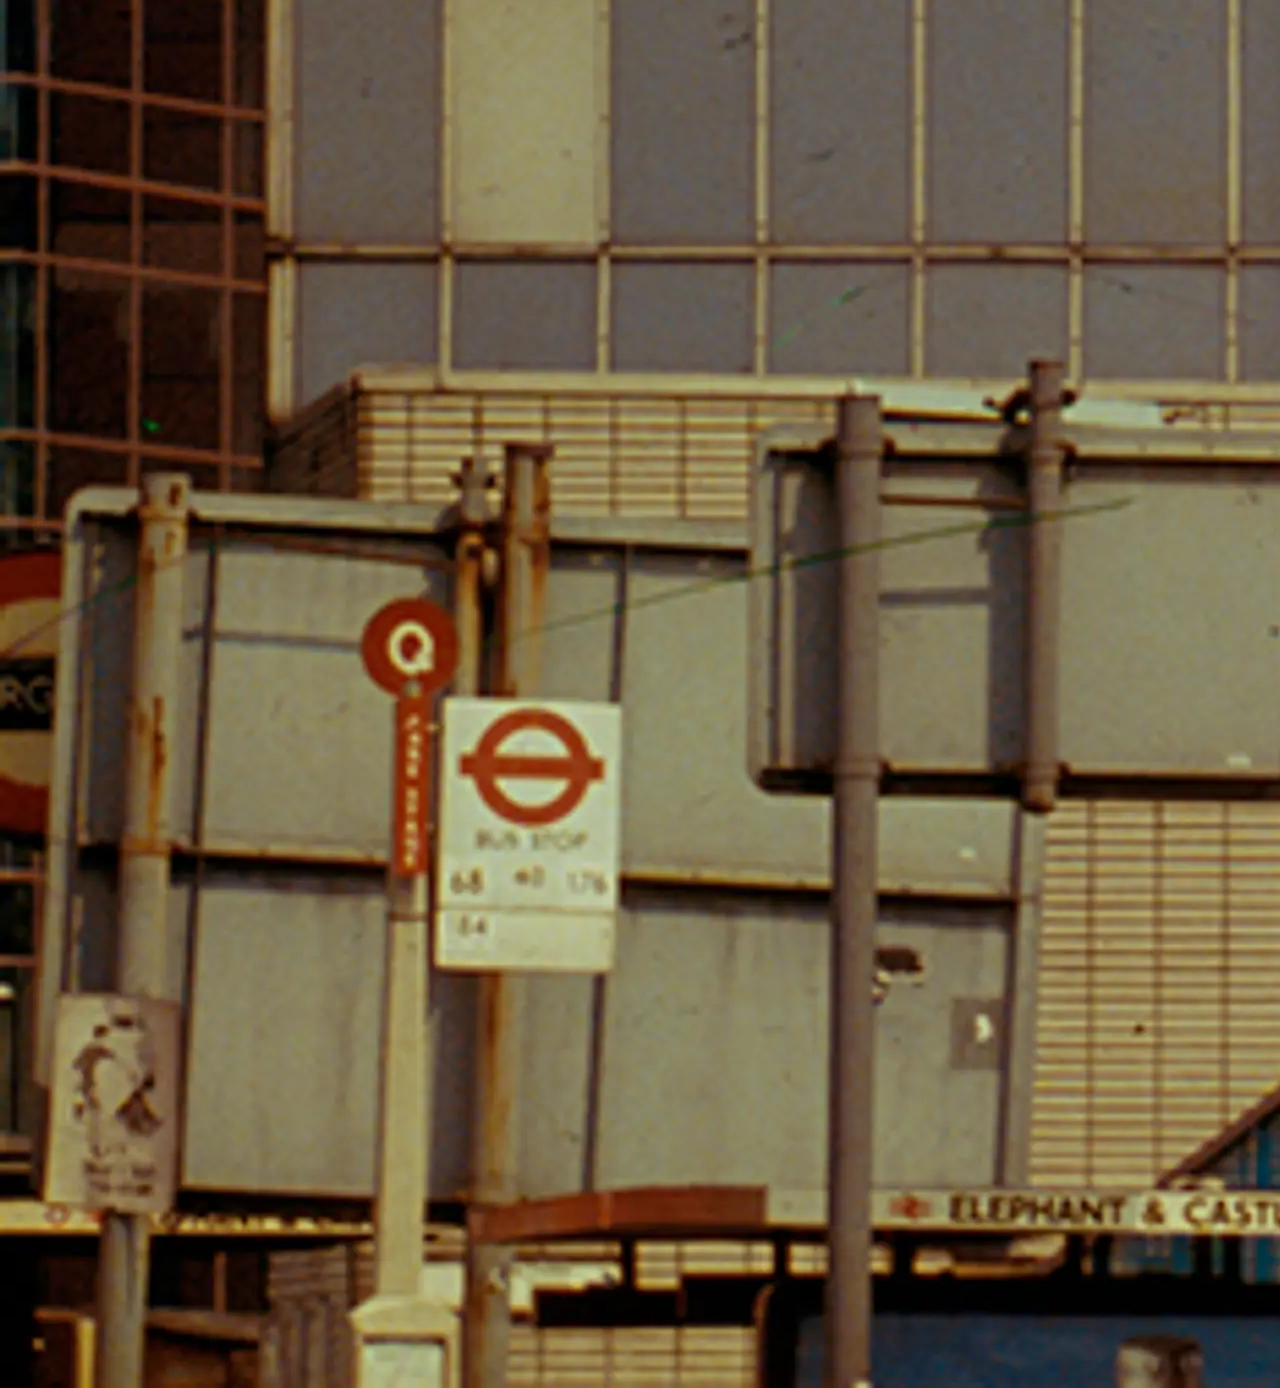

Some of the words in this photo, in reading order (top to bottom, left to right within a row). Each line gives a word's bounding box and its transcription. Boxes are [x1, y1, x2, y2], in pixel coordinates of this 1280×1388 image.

[387, 620, 435, 677] Q
[948, 1191, 1127, 1224] ELEPHANT
[1142, 1195, 1166, 1225] &
